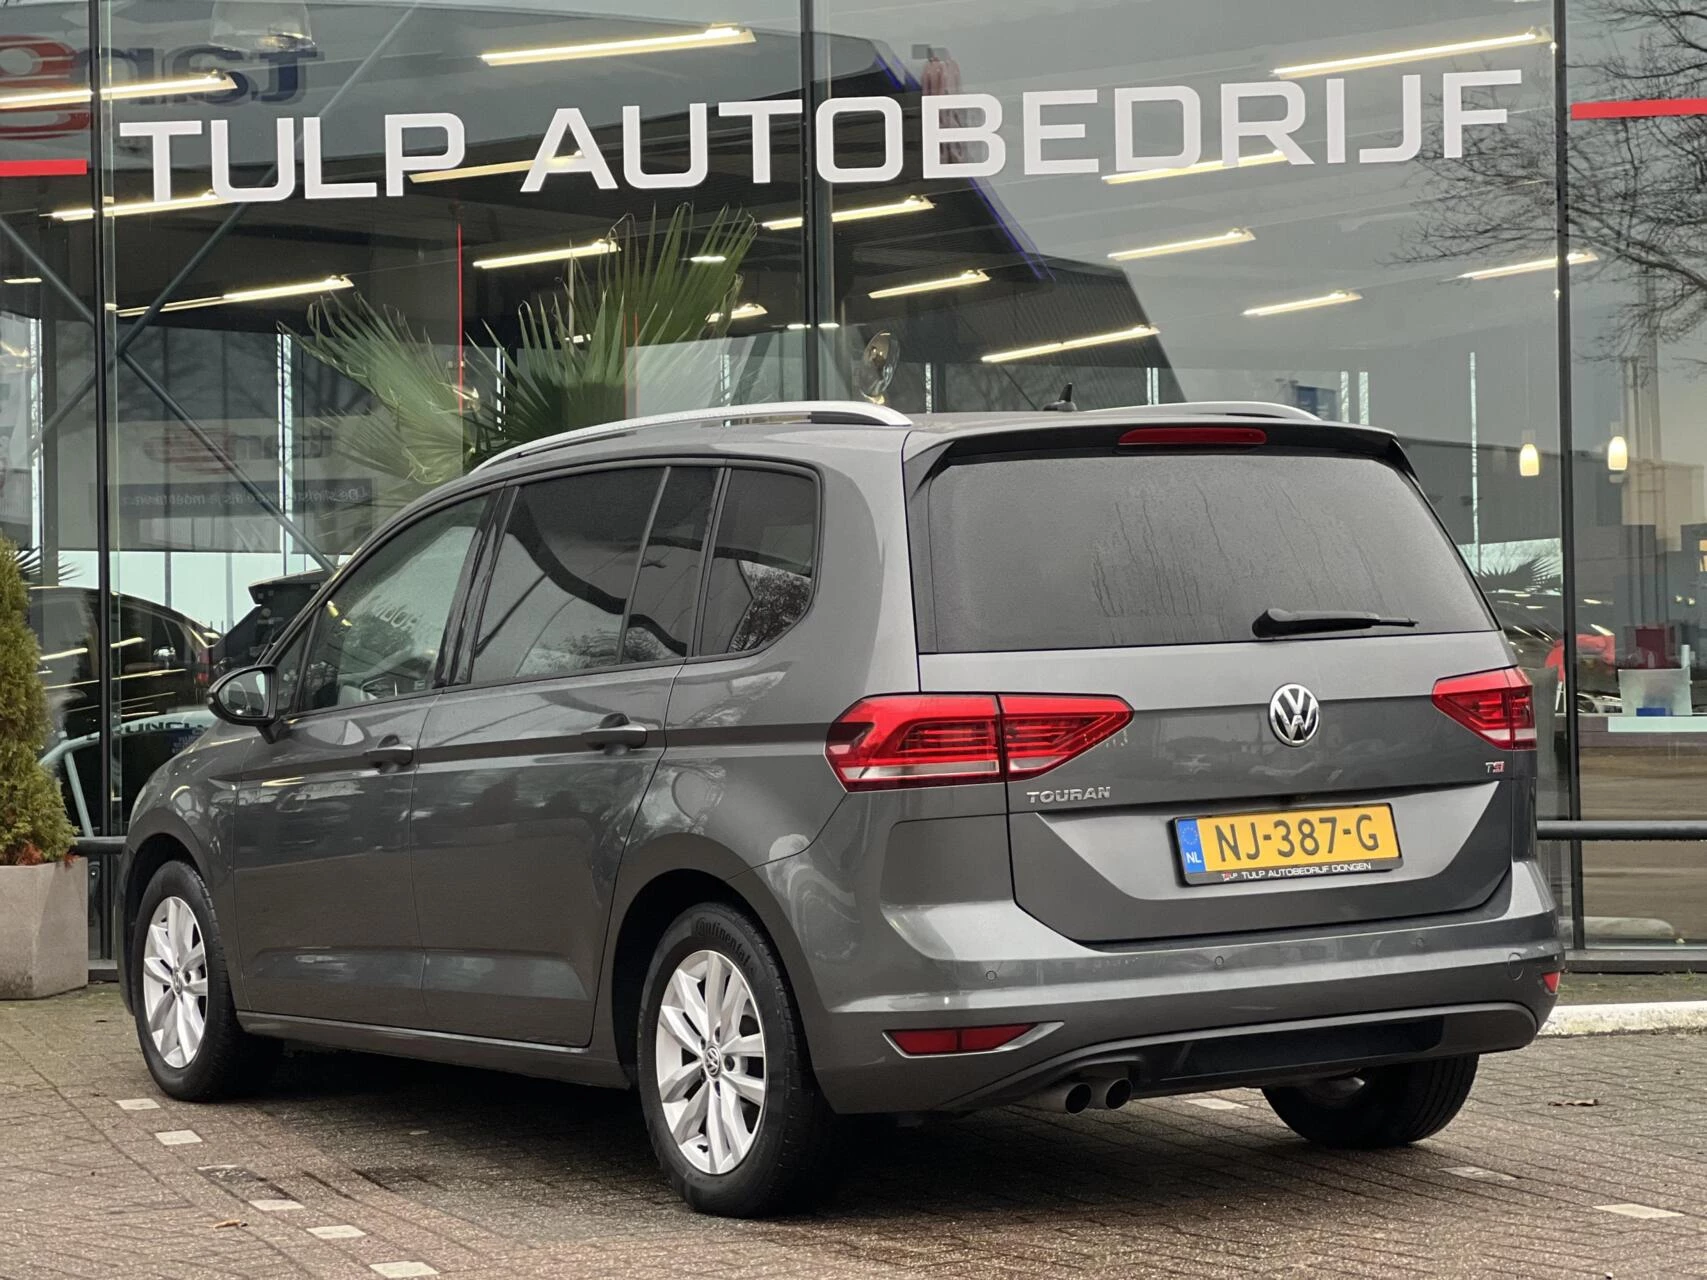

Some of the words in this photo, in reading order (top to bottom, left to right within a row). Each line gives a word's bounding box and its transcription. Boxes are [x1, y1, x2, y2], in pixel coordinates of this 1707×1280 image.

[118, 112, 466, 206] TULP
[520, 69, 1523, 193] AUTOBEDRIJF
[1485, 761, 1505, 773] TSI
[1027, 786, 1112, 804] TOURAN
[1215, 814, 1379, 862] NJ-387-G
[1186, 851, 1202, 864] NL
[1242, 871, 1265, 880] TULP
[1267, 865, 1329, 878] AUTOBEDRIJF
[1332, 862, 1371, 873] DONGEN
